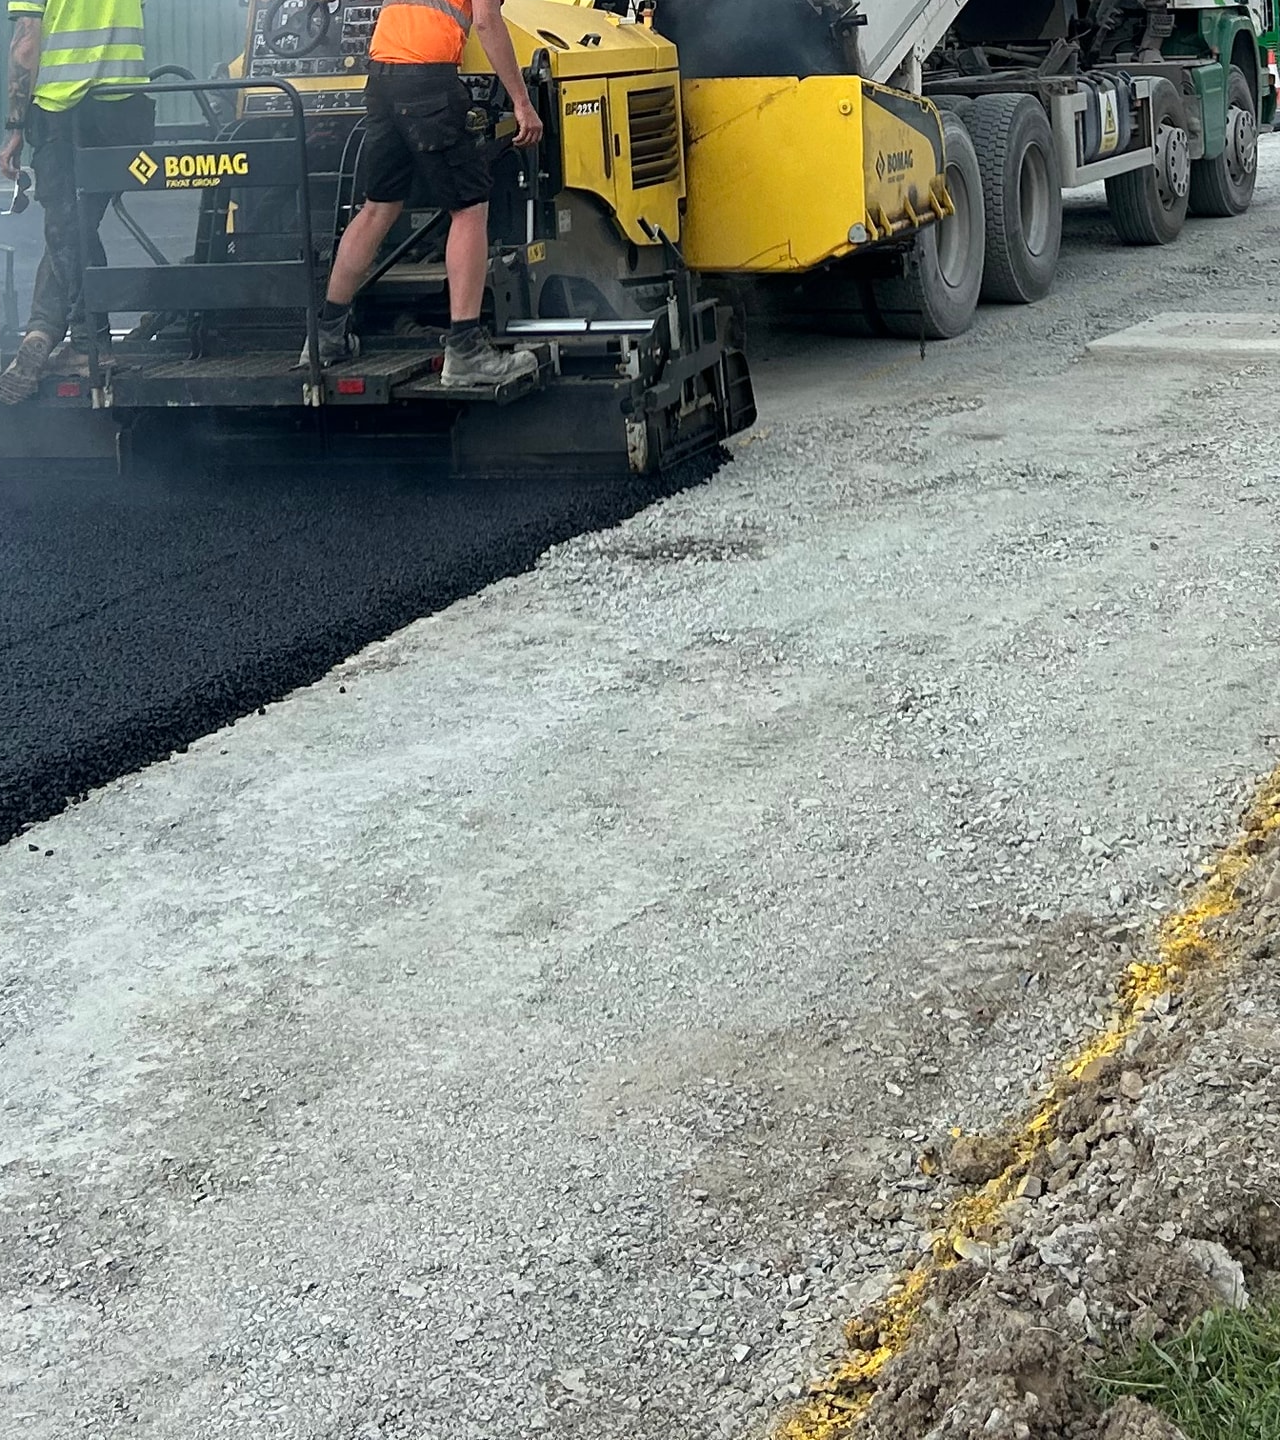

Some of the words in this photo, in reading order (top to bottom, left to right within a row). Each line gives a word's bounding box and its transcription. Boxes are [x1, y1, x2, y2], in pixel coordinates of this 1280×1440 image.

[164, 152, 249, 177] BOMAG
[887, 149, 914, 174] BOMAG
[192, 177, 221, 187] GROUP
